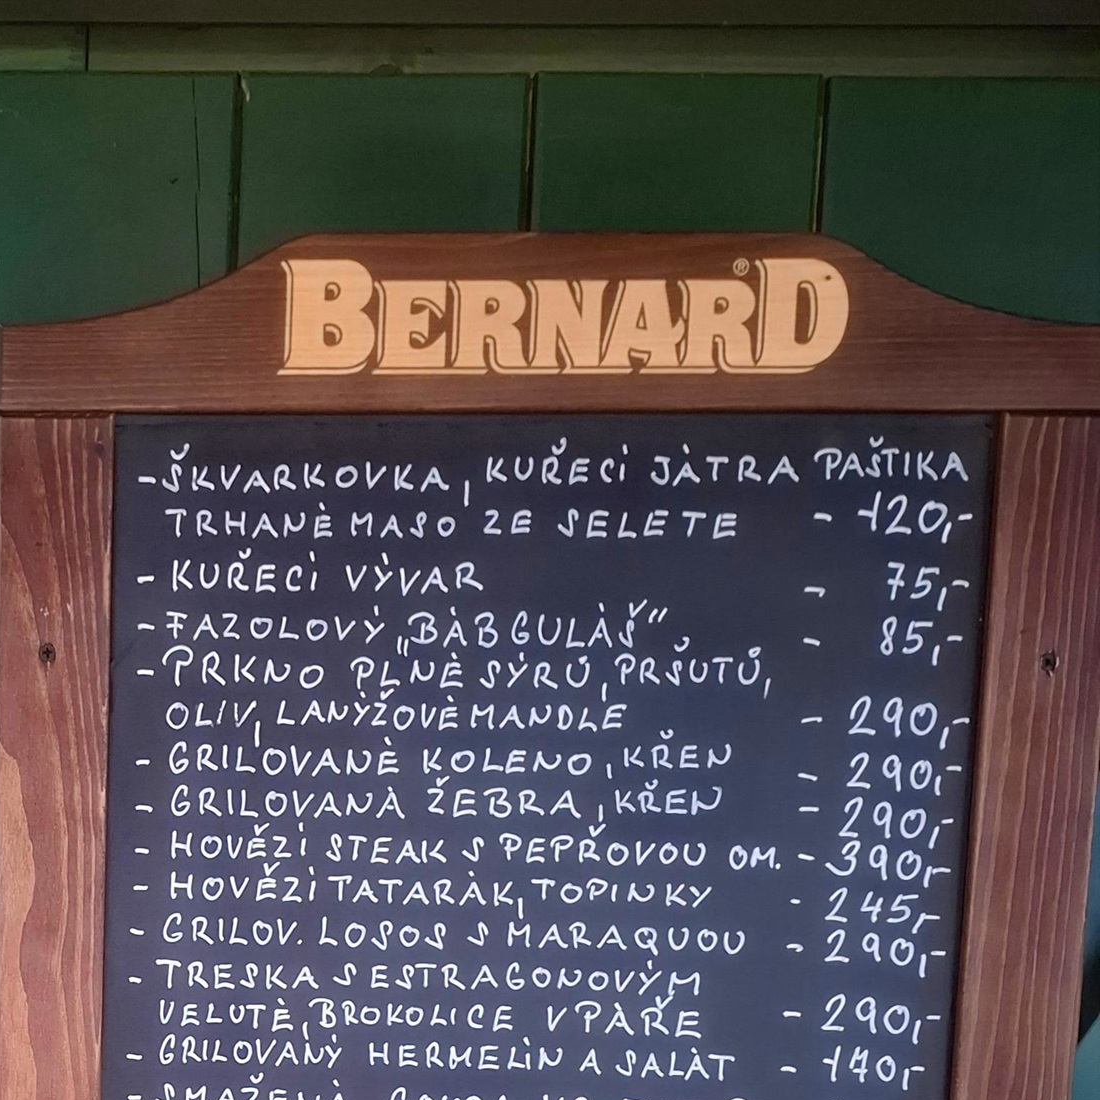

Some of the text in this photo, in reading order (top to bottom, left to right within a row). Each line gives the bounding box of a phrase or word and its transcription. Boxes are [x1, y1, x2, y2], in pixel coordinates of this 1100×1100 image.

[276, 258, 849, 375] BERNARD
[813, 436, 969, 482] PAŠTIKA
[350, 511, 456, 539] MASO
[483, 509, 532, 535] ZE
[557, 508, 738, 540] SELETE
[161, 644, 325, 689] PRKNO
[470, 703, 628, 733] MANDLE
[623, 728, 732, 769] KŘEN
[614, 778, 723, 816] KŘEN
[325, 833, 447, 865] STEAK
[461, 836, 485, 862] S
[498, 823, 707, 867] PEPŘOVOU
[728, 844, 781, 871] OM.
[530, 877, 713, 908] TOPINKY
[318, 916, 447, 951] LOSOS
[466, 921, 489, 947] S
[507, 921, 746, 957] MARAQUOU
[155, 958, 320, 990] TRESKA
[332, 962, 357, 986] S
[307, 997, 514, 1033] BROKOLICE
[547, 1005, 568, 1032] V
[579, 1048, 602, 1075] A
